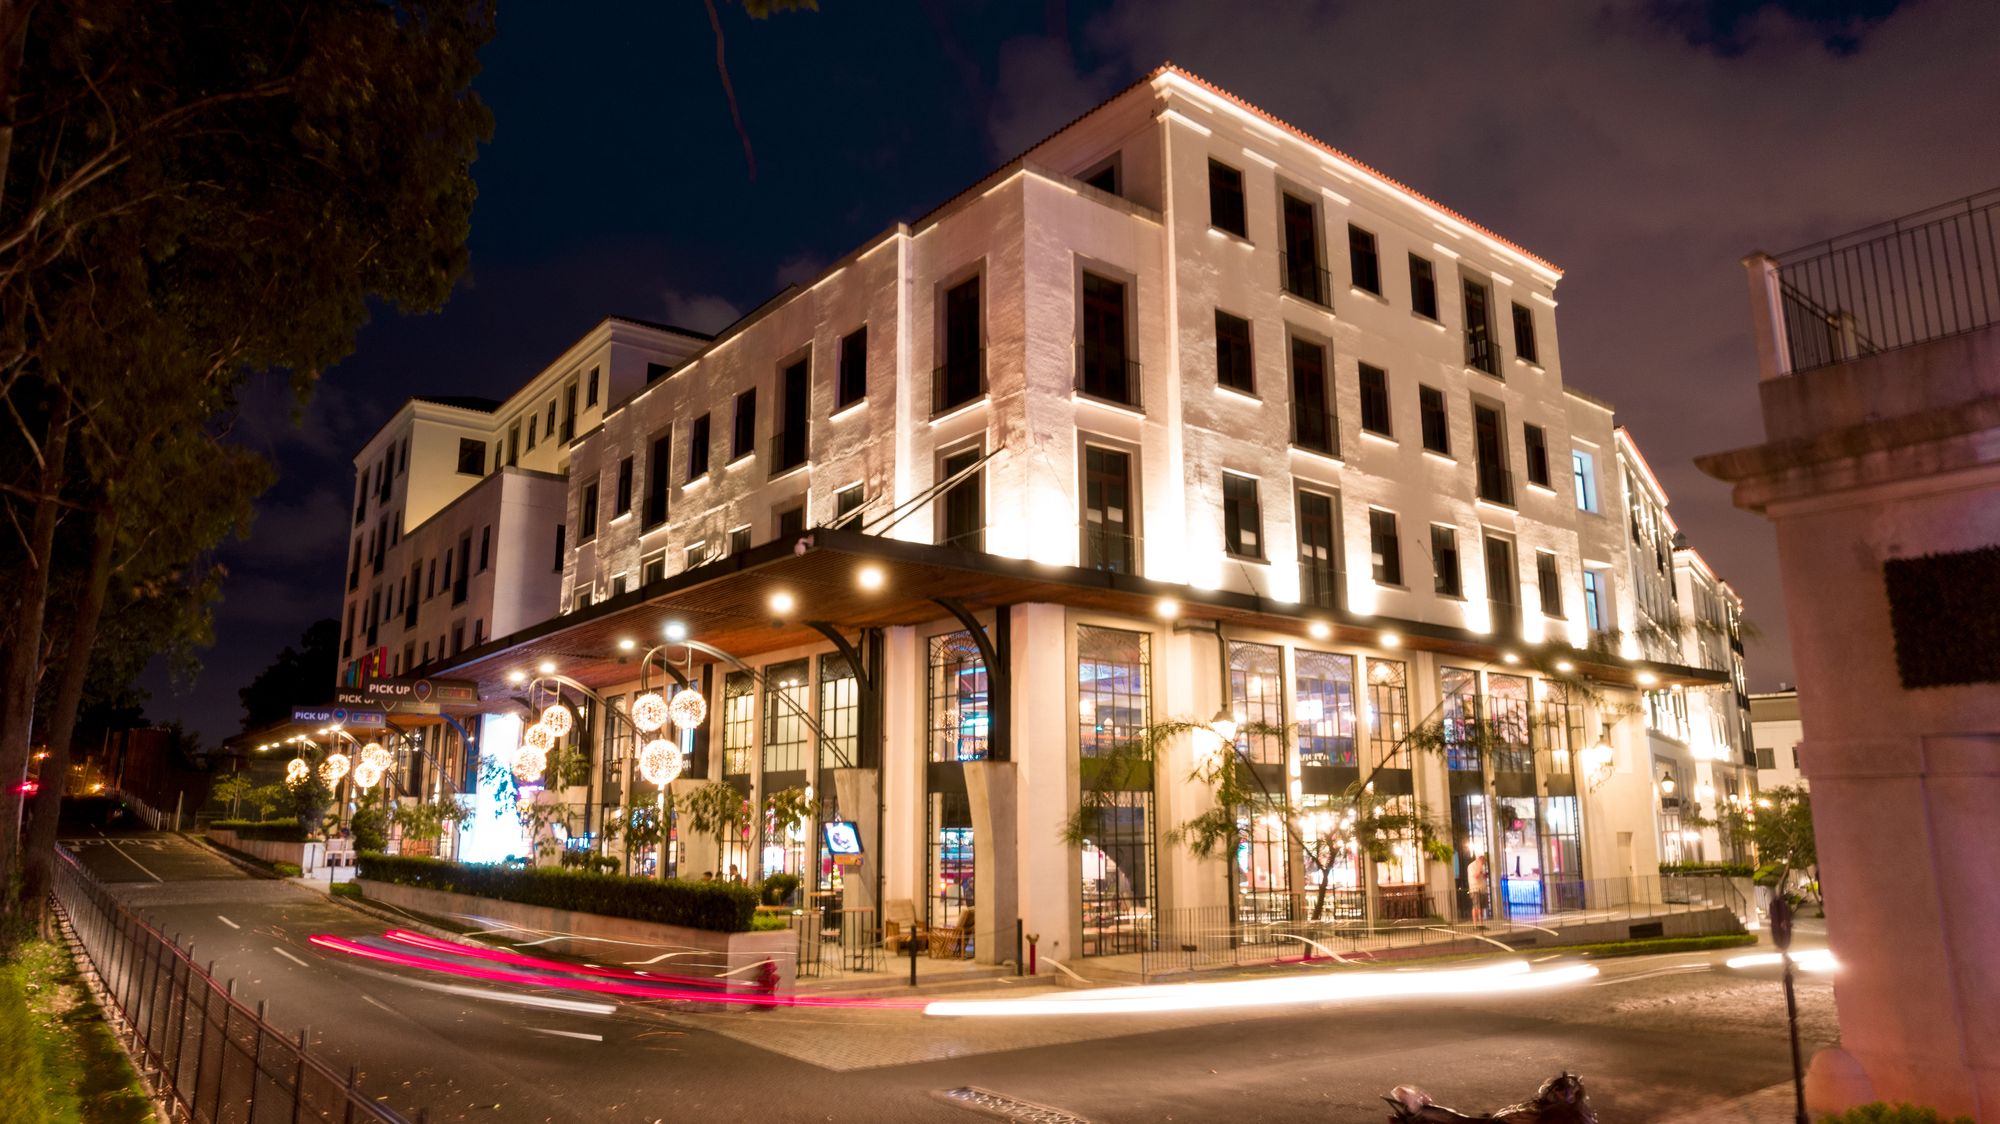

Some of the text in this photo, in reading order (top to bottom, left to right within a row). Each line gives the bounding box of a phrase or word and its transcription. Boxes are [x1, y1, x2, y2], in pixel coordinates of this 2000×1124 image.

[369, 684, 411, 695] PICK UP
[338, 694, 362, 703] PICK
[295, 711, 330, 721] PICK UP
